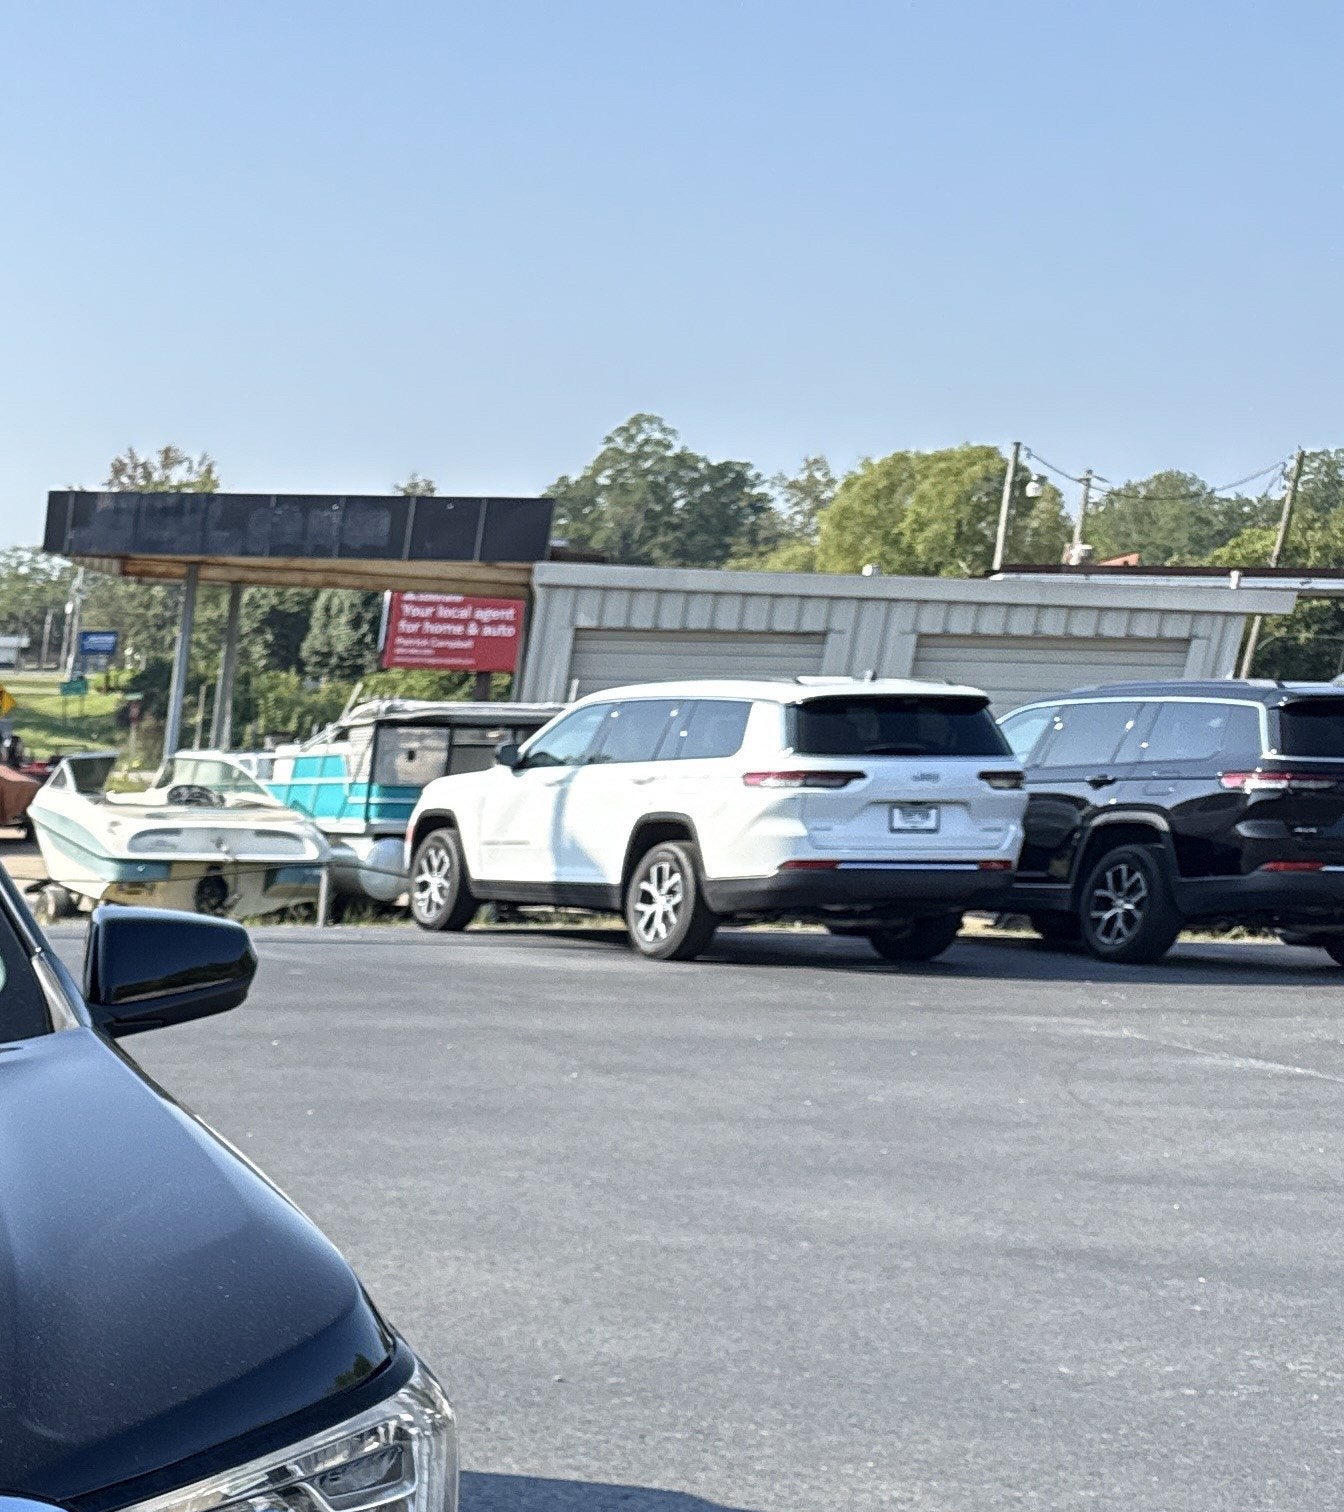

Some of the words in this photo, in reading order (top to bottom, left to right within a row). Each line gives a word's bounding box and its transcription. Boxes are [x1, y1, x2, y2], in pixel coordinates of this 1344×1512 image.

[402, 604, 435, 618] Your
[437, 604, 472, 619] local
[474, 607, 515, 622] agent
[399, 619, 422, 633] for
[423, 621, 465, 635] home
[467, 621, 479, 636] &
[482, 624, 515, 637] auto
